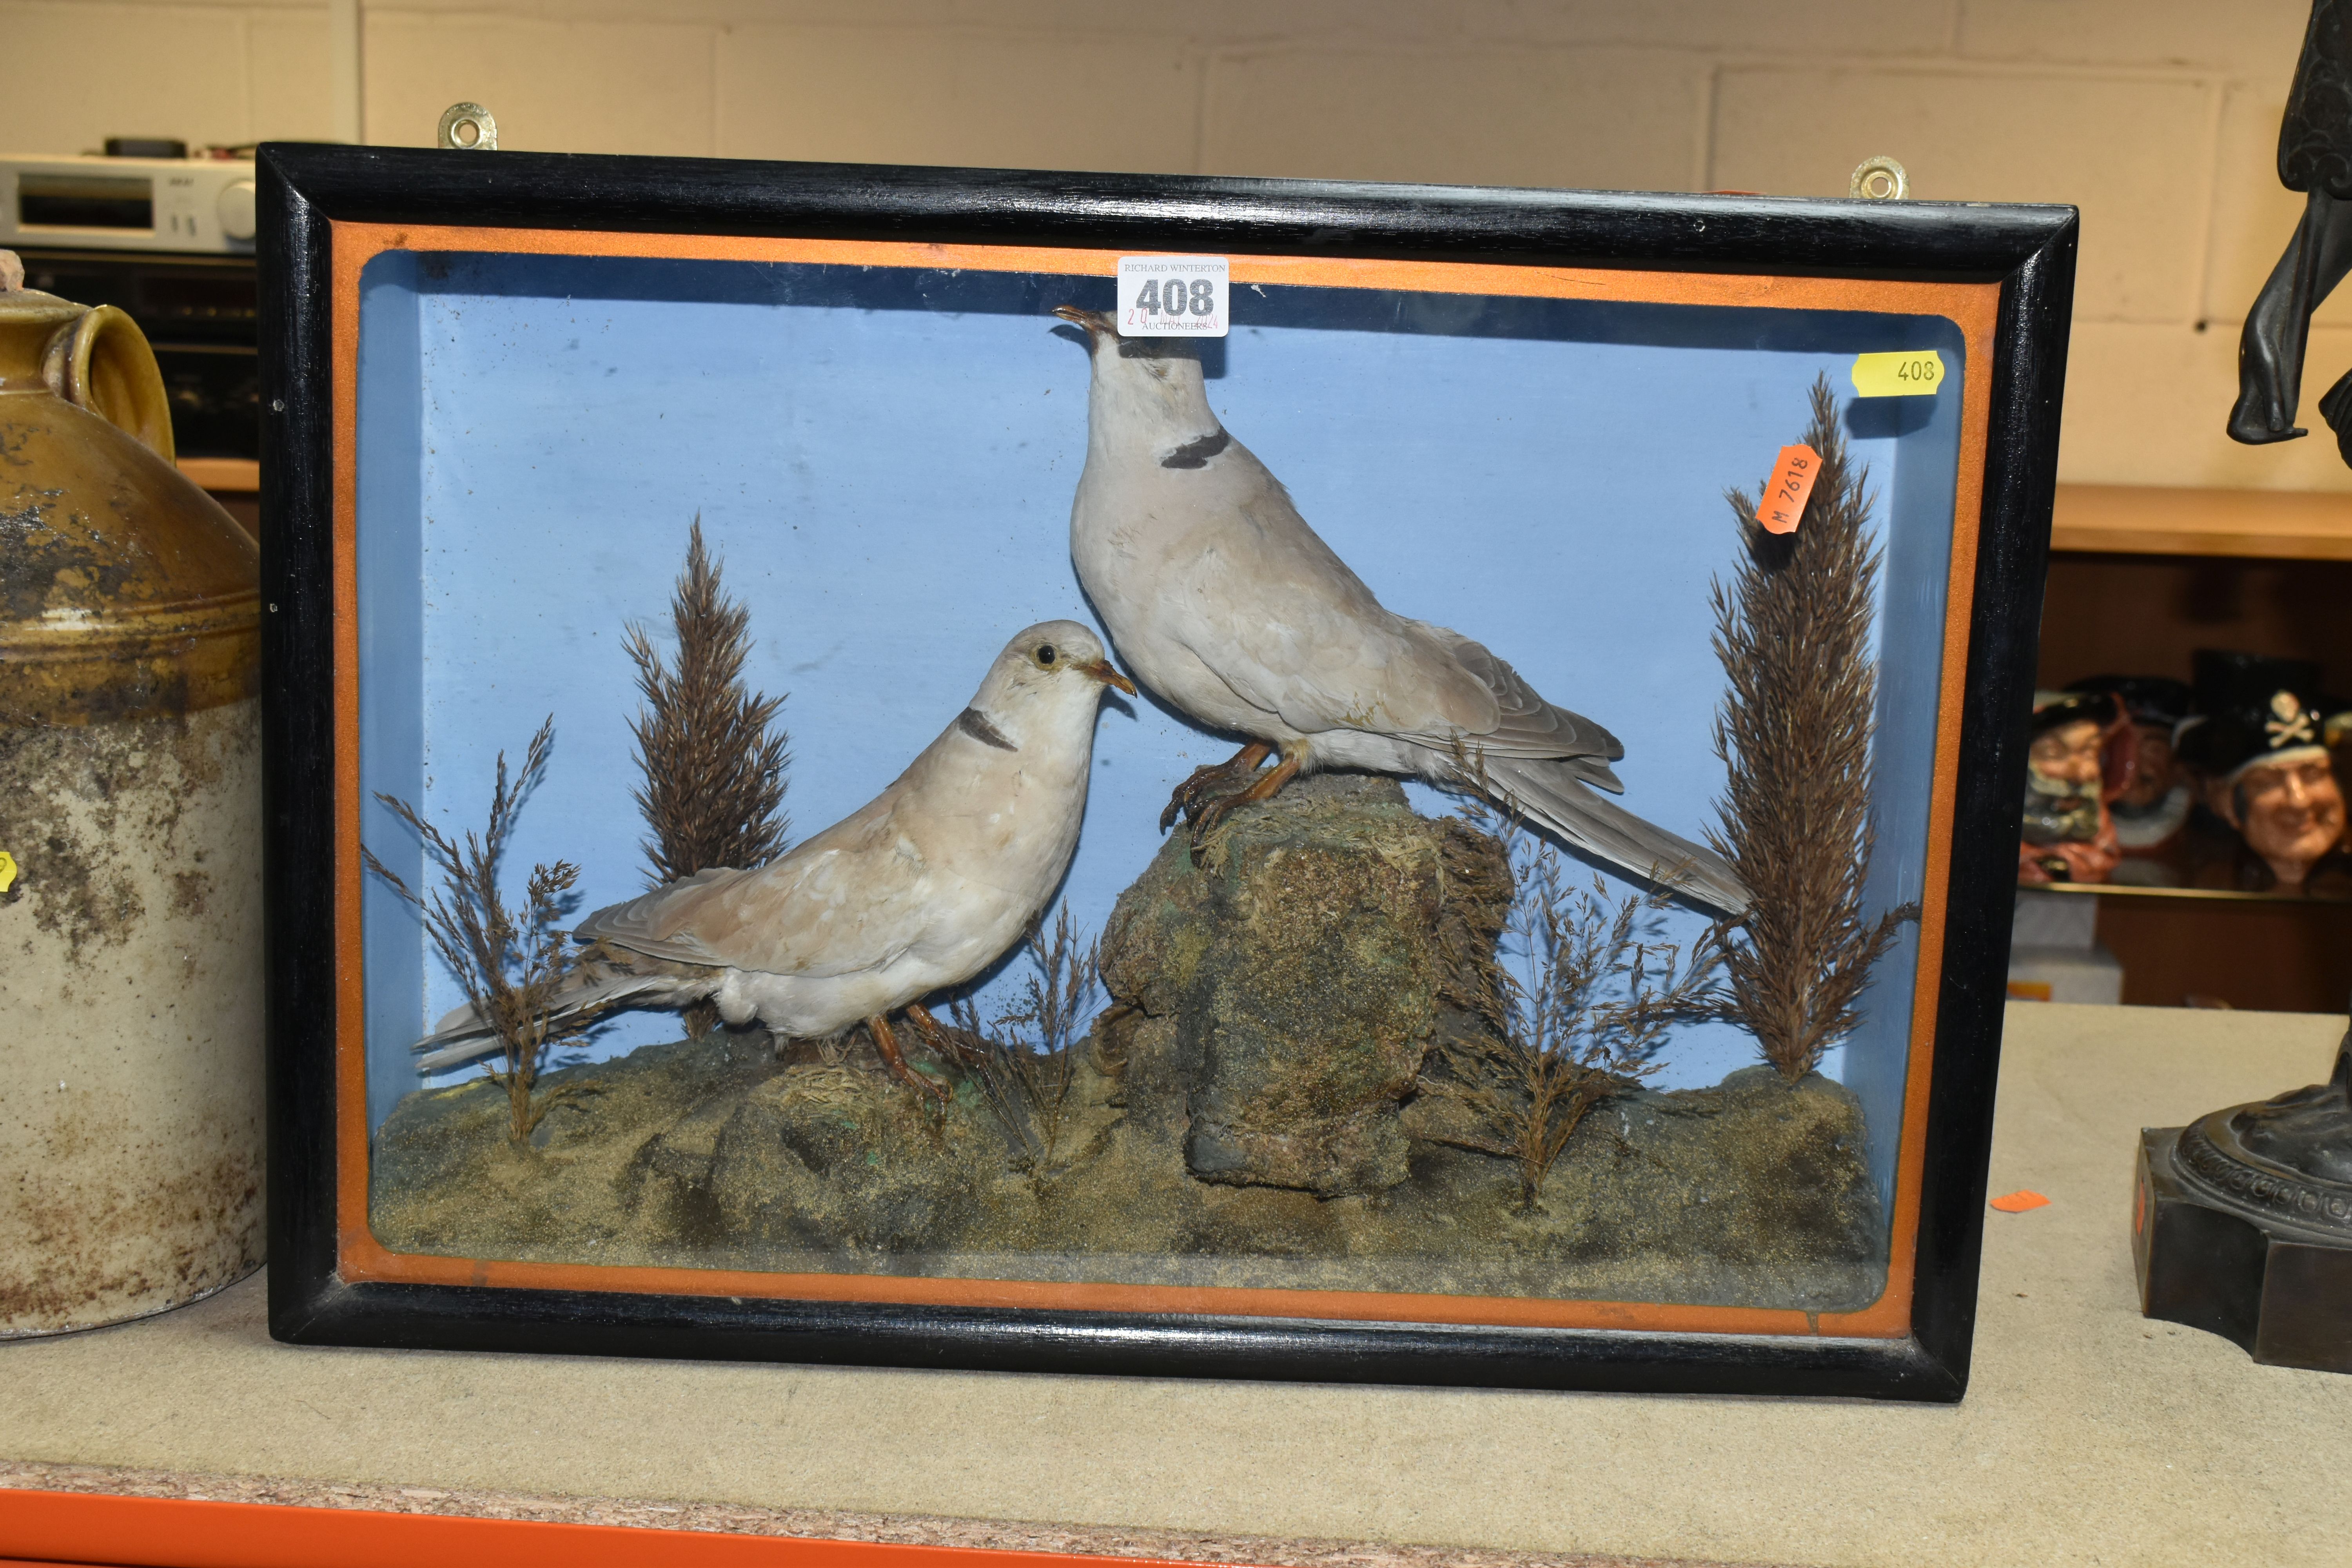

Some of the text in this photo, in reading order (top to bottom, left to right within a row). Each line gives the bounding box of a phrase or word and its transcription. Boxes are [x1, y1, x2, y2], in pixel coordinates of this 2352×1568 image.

[1136, 279, 1214, 316] 408
[1898, 361, 1935, 381] 408
[1772, 457, 1808, 523] M 7618
